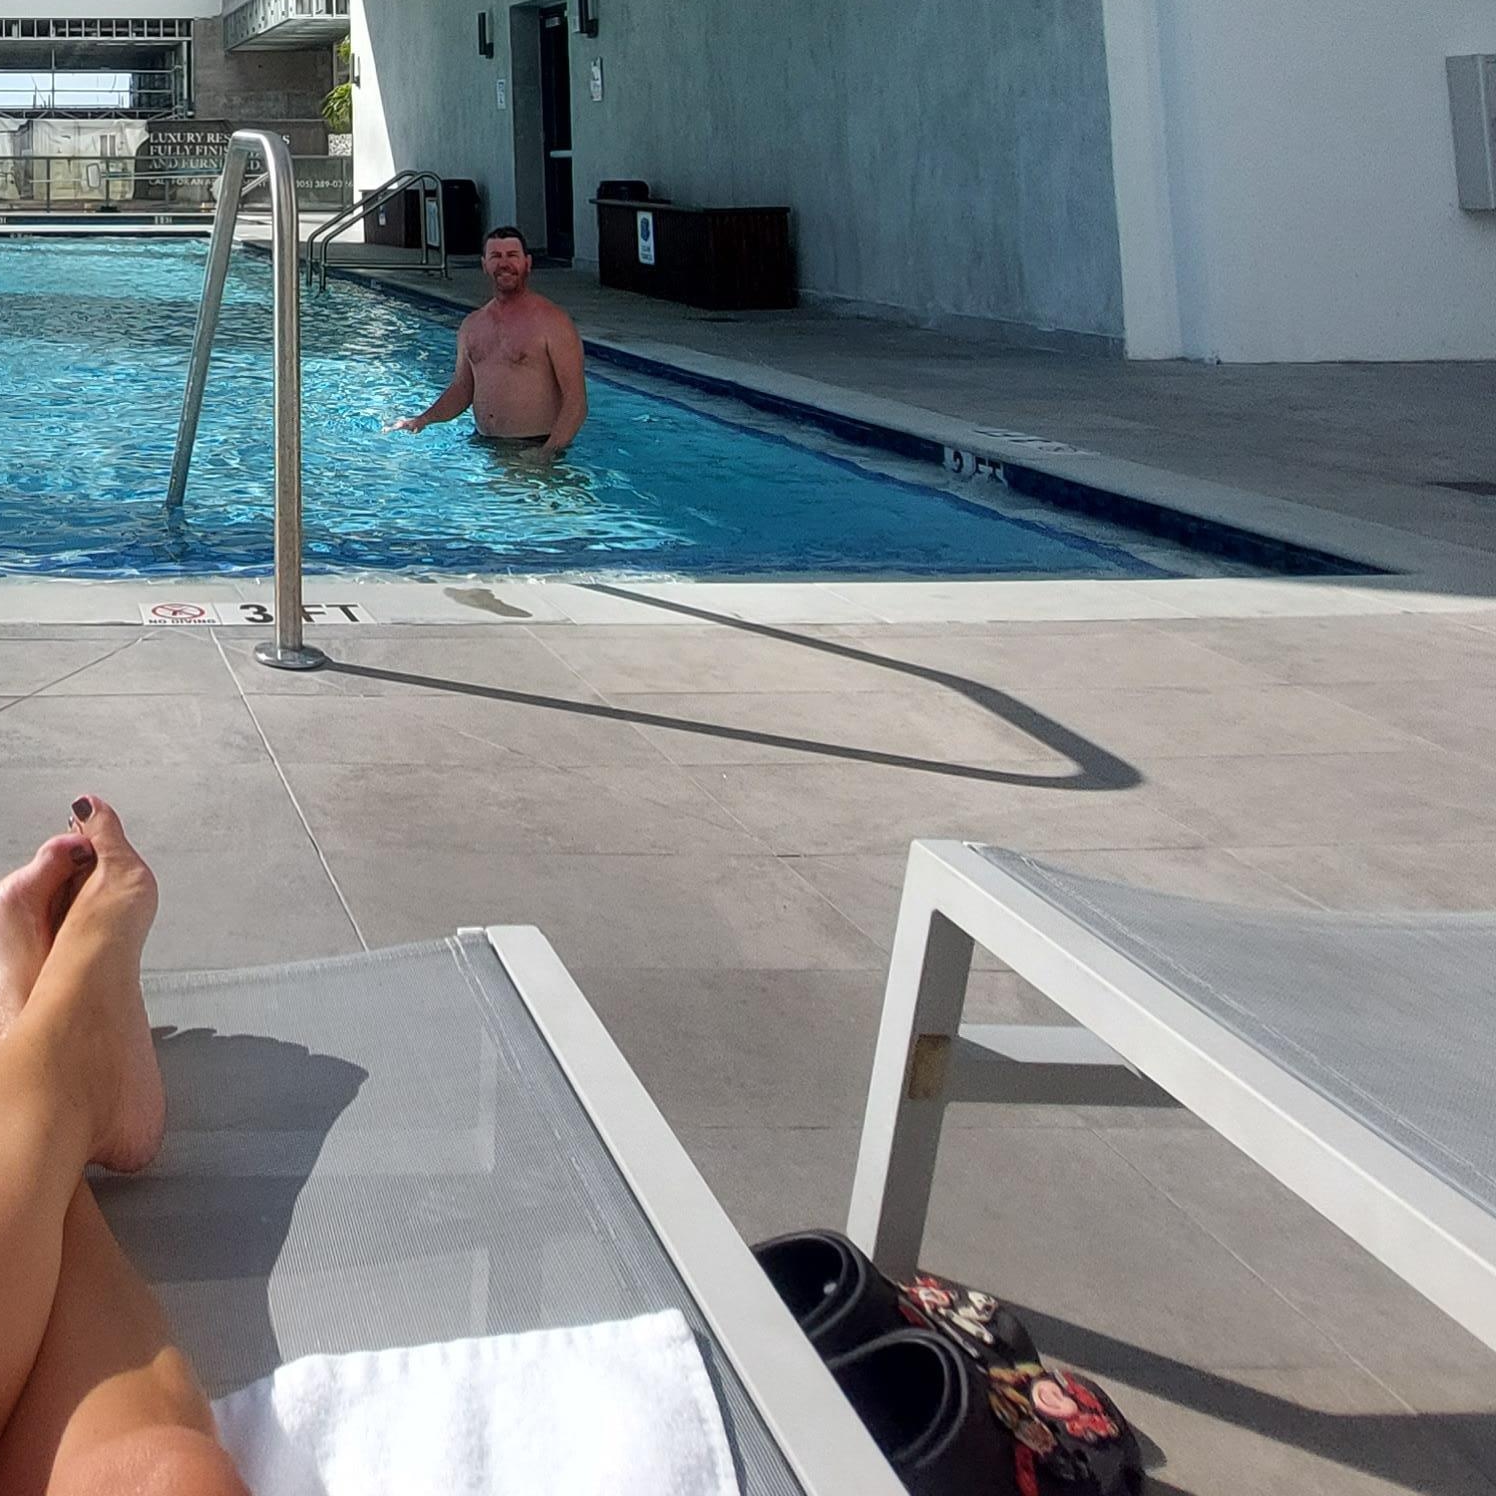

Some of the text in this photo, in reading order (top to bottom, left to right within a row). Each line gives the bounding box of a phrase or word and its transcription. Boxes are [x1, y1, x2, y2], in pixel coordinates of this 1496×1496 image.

[150, 132, 204, 144] LUXURY
[150, 145, 192, 156] FULLY
[149, 158, 178, 169] AND
[239, 604, 361, 623] 3 FT
